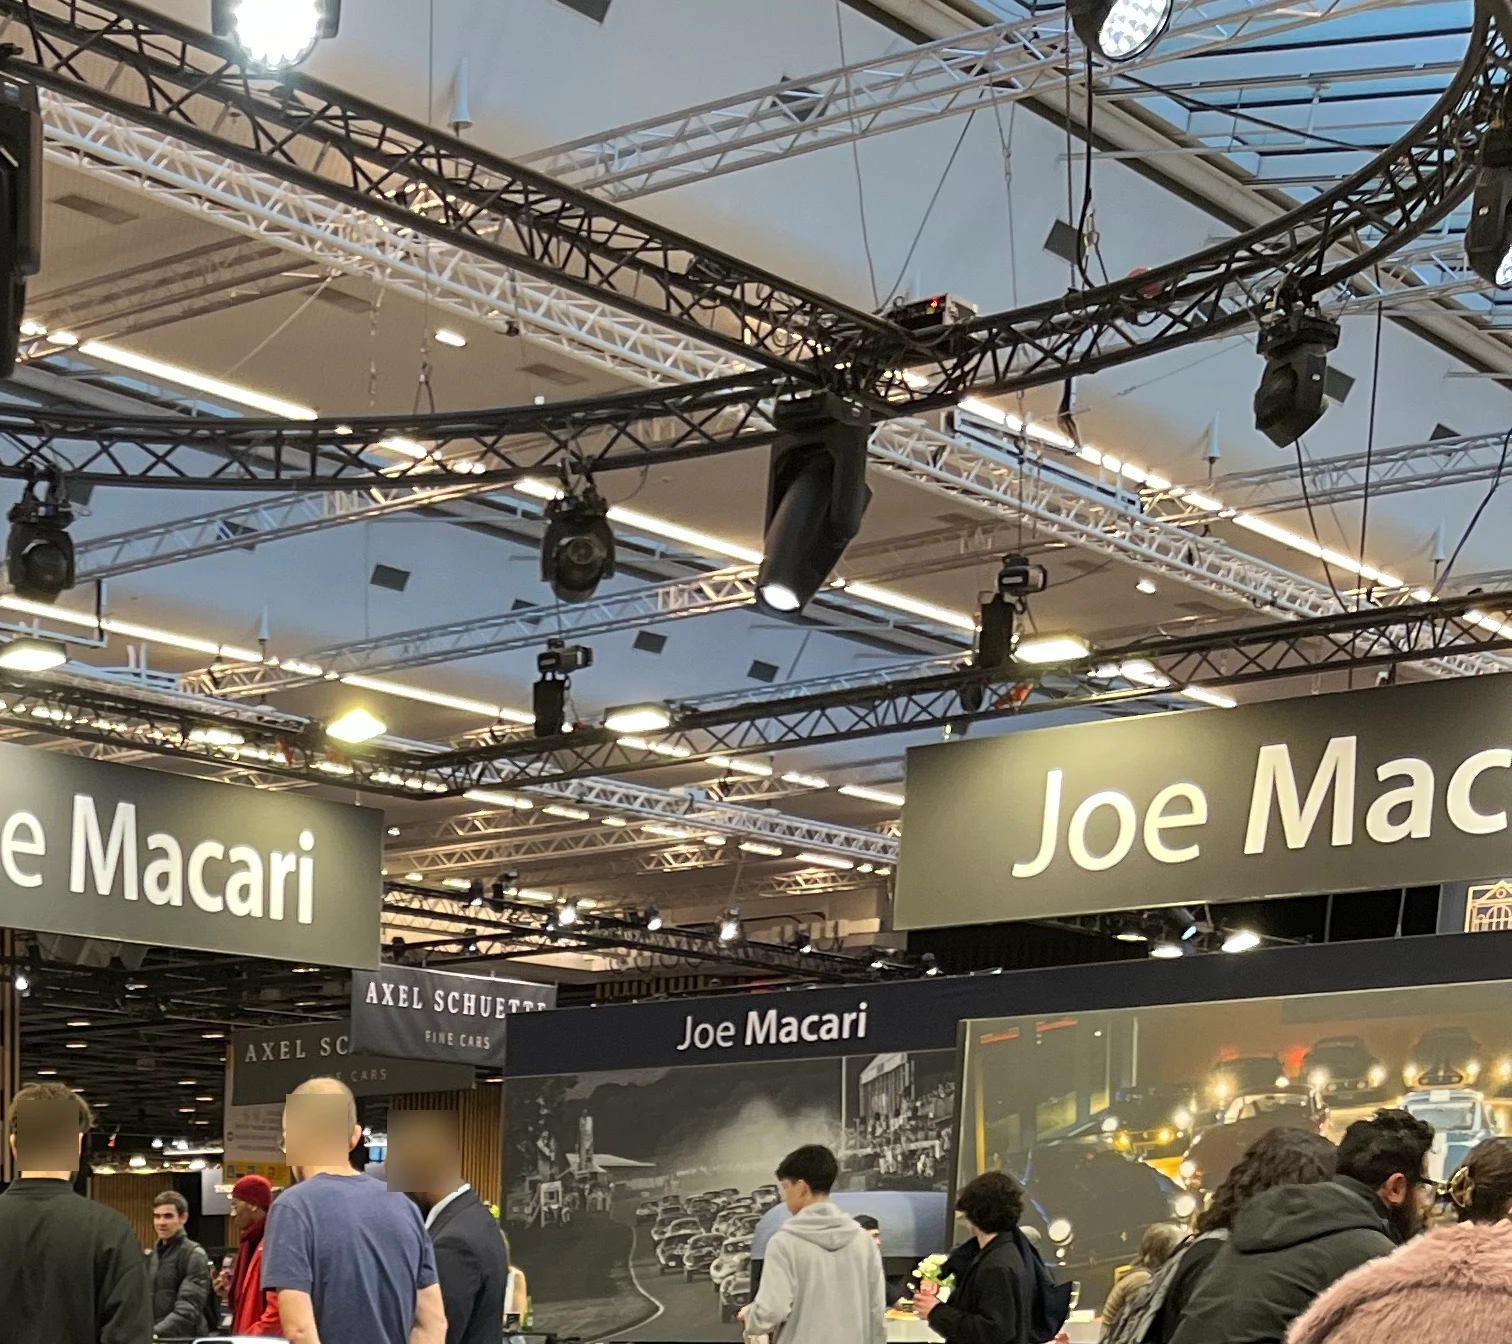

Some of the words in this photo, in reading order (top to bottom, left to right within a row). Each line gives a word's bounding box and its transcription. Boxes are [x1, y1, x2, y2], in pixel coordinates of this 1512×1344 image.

[1012, 770, 1209, 879] Joe
[1244, 736, 1512, 855] Mac
[70, 795, 315, 924] Macari
[365, 981, 423, 1009] AXEL
[425, 1030, 453, 1046] FINE
[459, 1034, 491, 1050] CARS
[677, 1015, 735, 1053] Joe
[744, 1002, 867, 1046] Macari
[244, 1039, 306, 1063] AXEL
[351, 1069, 387, 1082] CARS
